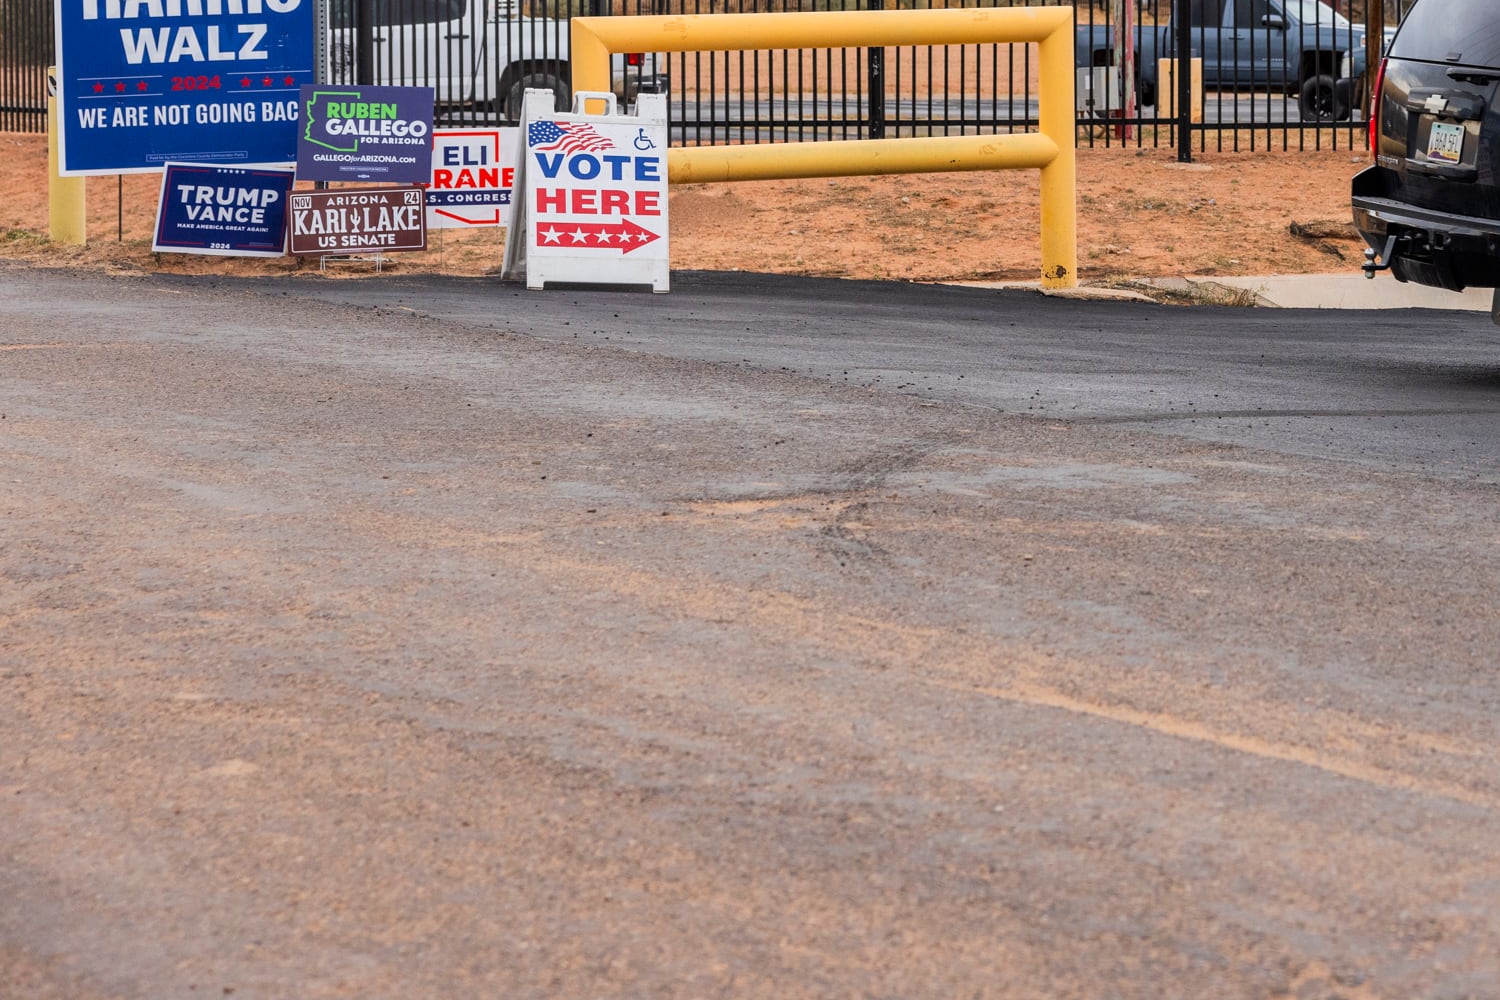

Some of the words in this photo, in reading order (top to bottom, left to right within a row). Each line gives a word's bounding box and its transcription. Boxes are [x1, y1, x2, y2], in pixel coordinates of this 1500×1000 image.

[120, 24, 268, 65] WALZ
[171, 75, 221, 91] 2024
[78, 108, 107, 129] WE
[112, 106, 149, 128] ARE
[154, 105, 190, 126] NOT
[195, 102, 256, 124] GOING
[262, 101, 299, 122] BAC
[327, 102, 397, 119] RUBEN
[325, 118, 427, 137] GALLEGO
[360, 136, 379, 144] FOR
[381, 137, 425, 145] ARIZONA
[443, 145, 487, 166] ELI
[534, 152, 661, 182] VOTE
[425, 168, 515, 189] RANE
[177, 184, 279, 207] TRUMP
[294, 197, 311, 208] NOV
[326, 195, 388, 206] ARIZONA
[405, 192, 418, 204] 24
[536, 187, 661, 216] HERE
[185, 205, 265, 224] VANCE
[293, 208, 348, 235] KARI
[362, 205, 420, 232] LAKE
[318, 236, 337, 248] US
[341, 233, 396, 246] SENATE
